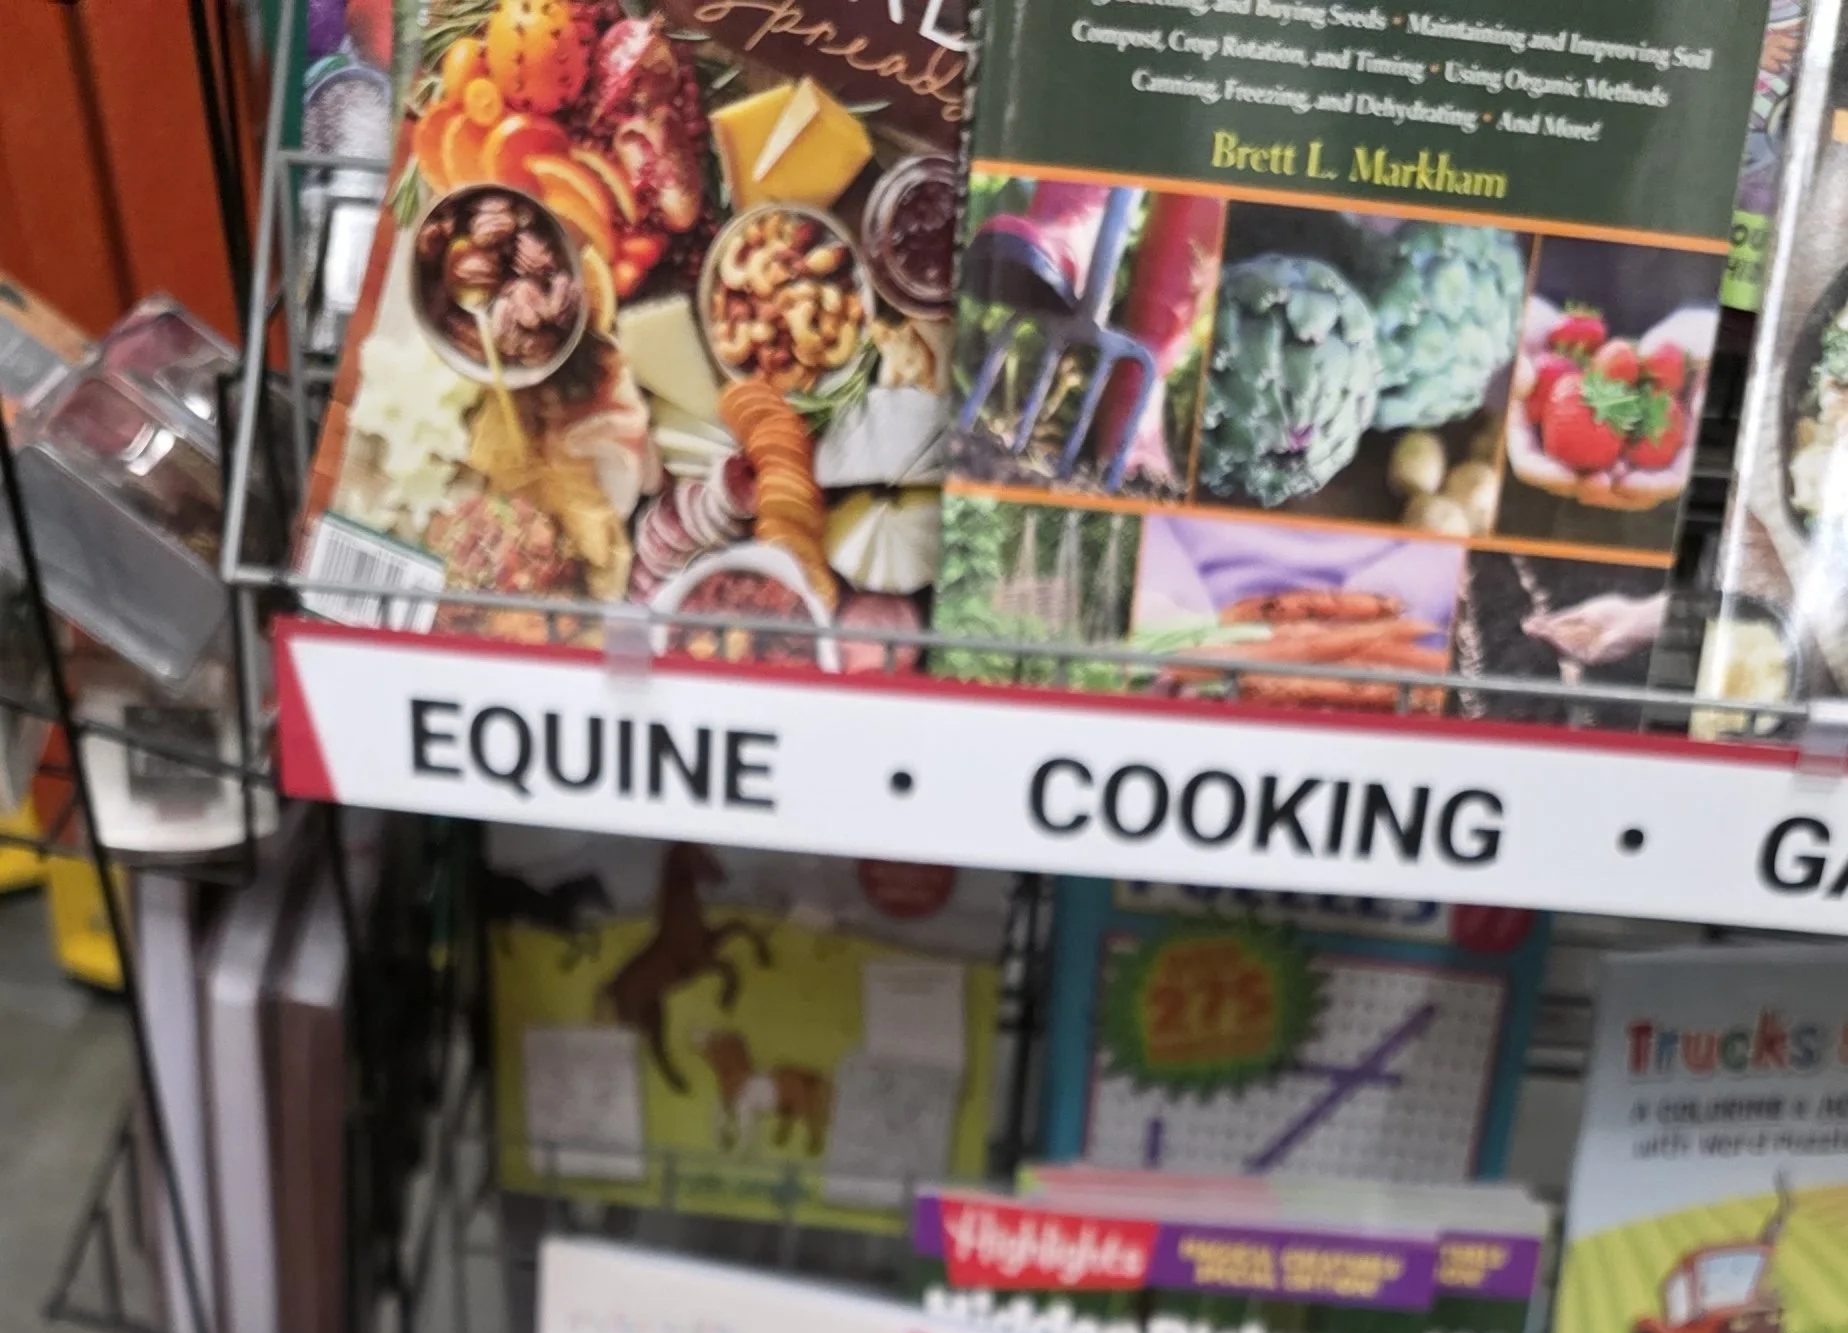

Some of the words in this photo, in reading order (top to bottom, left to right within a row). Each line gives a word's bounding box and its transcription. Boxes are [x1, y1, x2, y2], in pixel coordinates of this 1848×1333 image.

[1071, 18, 1166, 53] Compost,
[1167, 29, 1219, 61] Crop
[1221, 35, 1310, 68] Rotation,
[1310, 49, 1351, 70] and
[1356, 50, 1426, 84] Timing
[1444, 60, 1503, 94] Using
[1503, 67, 1583, 99] Organic
[1583, 77, 1671, 108] Methods
[1254, 0, 1327, 29] Buying
[1326, 4, 1388, 31] Seeds
[1406, 13, 1527, 54] Maintaining
[1527, 30, 1567, 52] and
[1569, 33, 1671, 71] Improving
[1672, 45, 1715, 70] Soil
[1131, 67, 1221, 105] Canning,
[1223, 77, 1313, 114] Freezing,
[1313, 91, 1353, 113] and
[1355, 94, 1480, 134] Dehydrating
[1496, 109, 1541, 134] And
[1541, 114, 1605, 142] More!
[1211, 128, 1297, 176] Brett
[1305, 138, 1339, 181] L.
[1348, 145, 1510, 199] Markham
[408, 696, 780, 810] EQUINE
[1029, 757, 1504, 867] COOKING
[1626, 1005, 1827, 1078] Trucks
[943, 1203, 1144, 1286] Highlights
